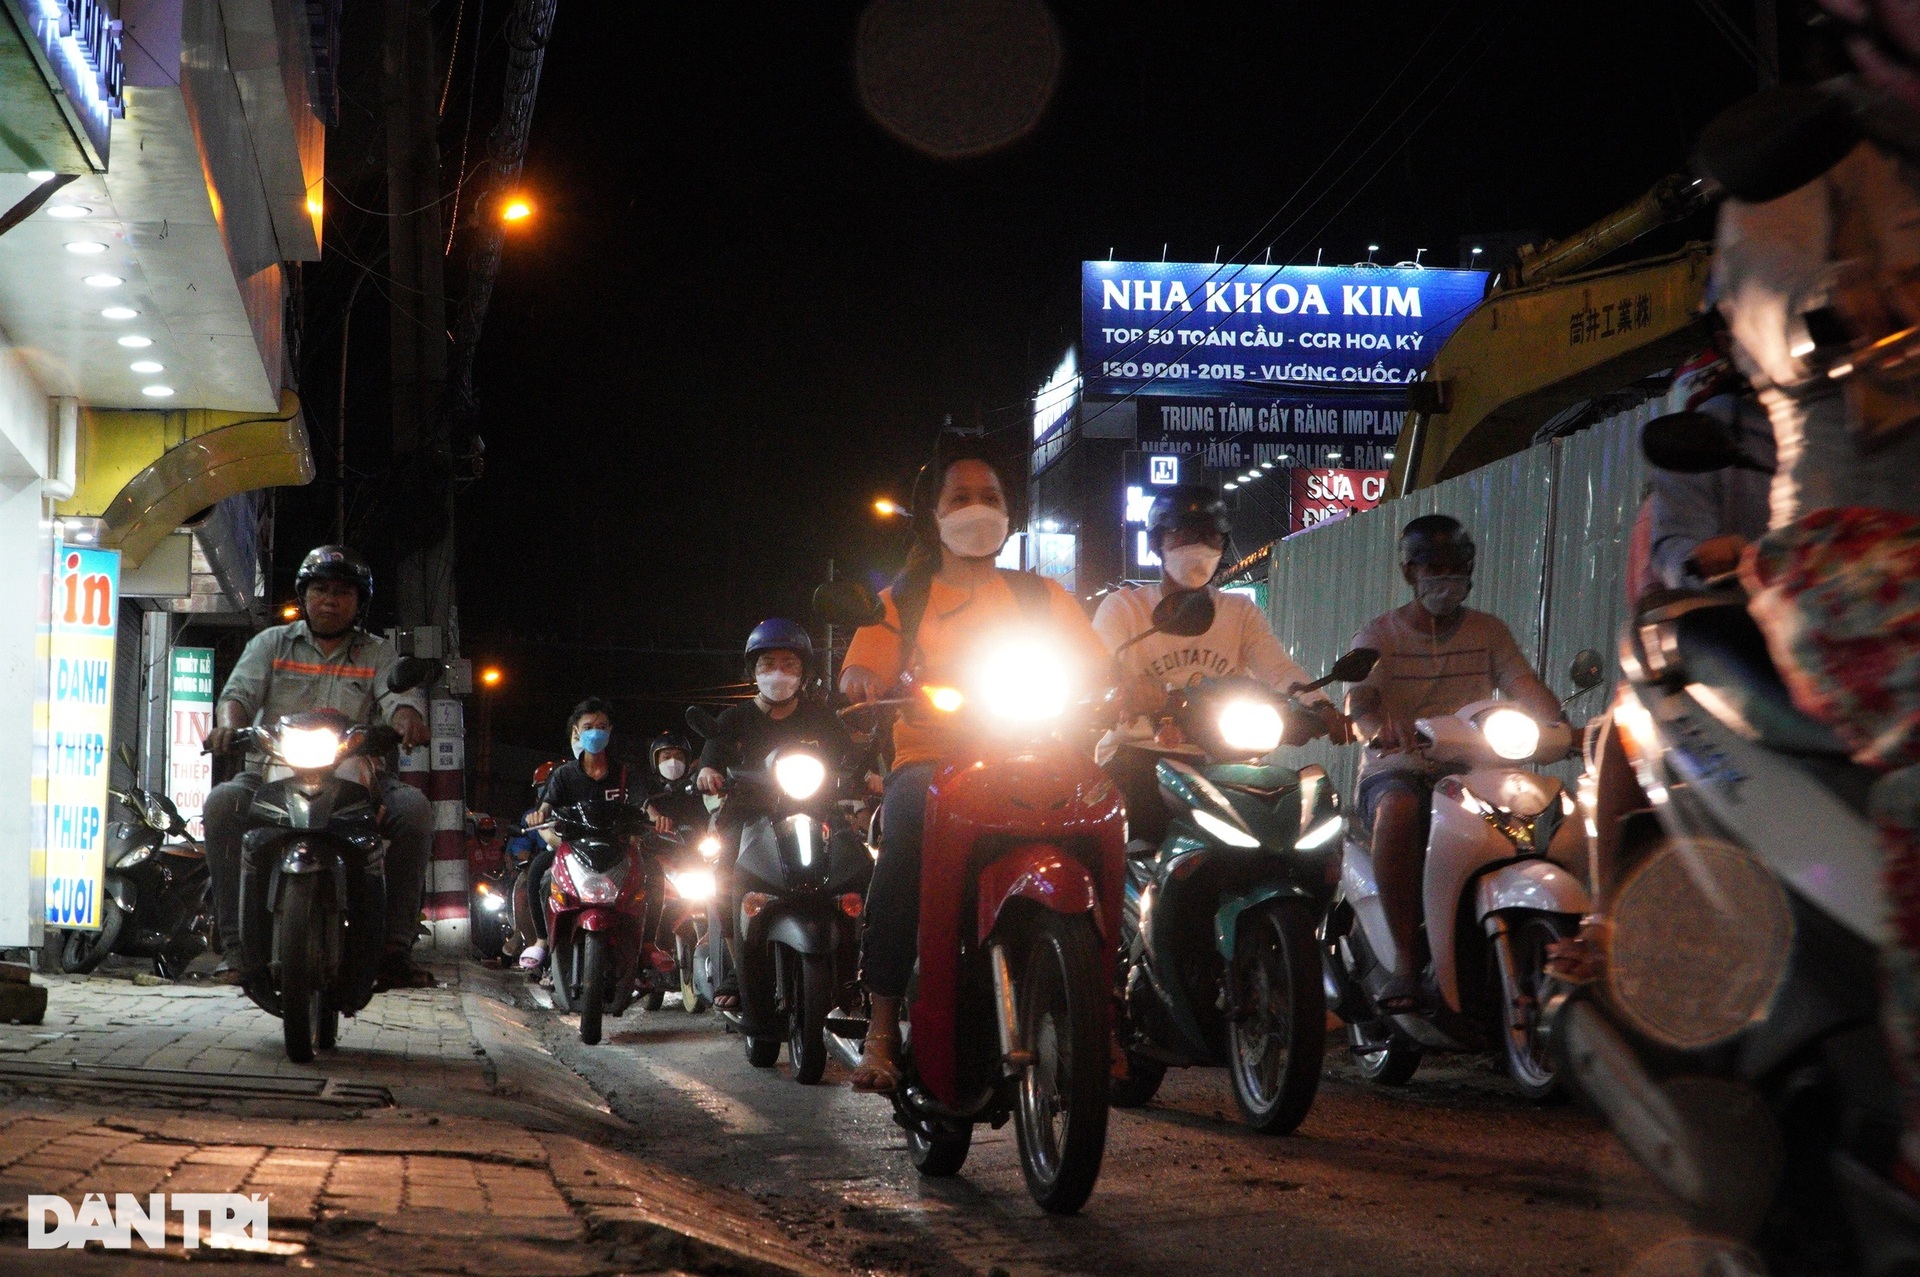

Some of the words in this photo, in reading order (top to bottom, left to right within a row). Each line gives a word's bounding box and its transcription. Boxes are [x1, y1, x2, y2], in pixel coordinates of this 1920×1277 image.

[1102, 279, 1194, 312] NHA
[1205, 281, 1330, 315] KHOA
[1342, 285, 1422, 317] KIM
[1102, 328, 1144, 344] TOP
[1148, 329, 1174, 345] 50
[1240, 324, 1283, 347] CẦU
[1299, 332, 1341, 348] CGR
[1346, 333, 1392, 349] HOA
[1396, 331, 1424, 350] KỲ
[1102, 361, 1138, 378] ISO
[1142, 363, 1245, 379] 9001-2015
[1261, 363, 1337, 381] VƯƠNG
[1161, 405, 1214, 432] TRUNG
[1219, 402, 1253, 432] TÂM
[1258, 400, 1290, 433] CẤY
[1294, 403, 1338, 434] RĂNG
[1342, 409, 1407, 435] IMPLAN
[1306, 469, 1355, 501] SỬA
[63, 553, 111, 627] in
[57, 658, 108, 704] DANH
[174, 710, 211, 747] IN
[172, 760, 210, 782] THIỆP
